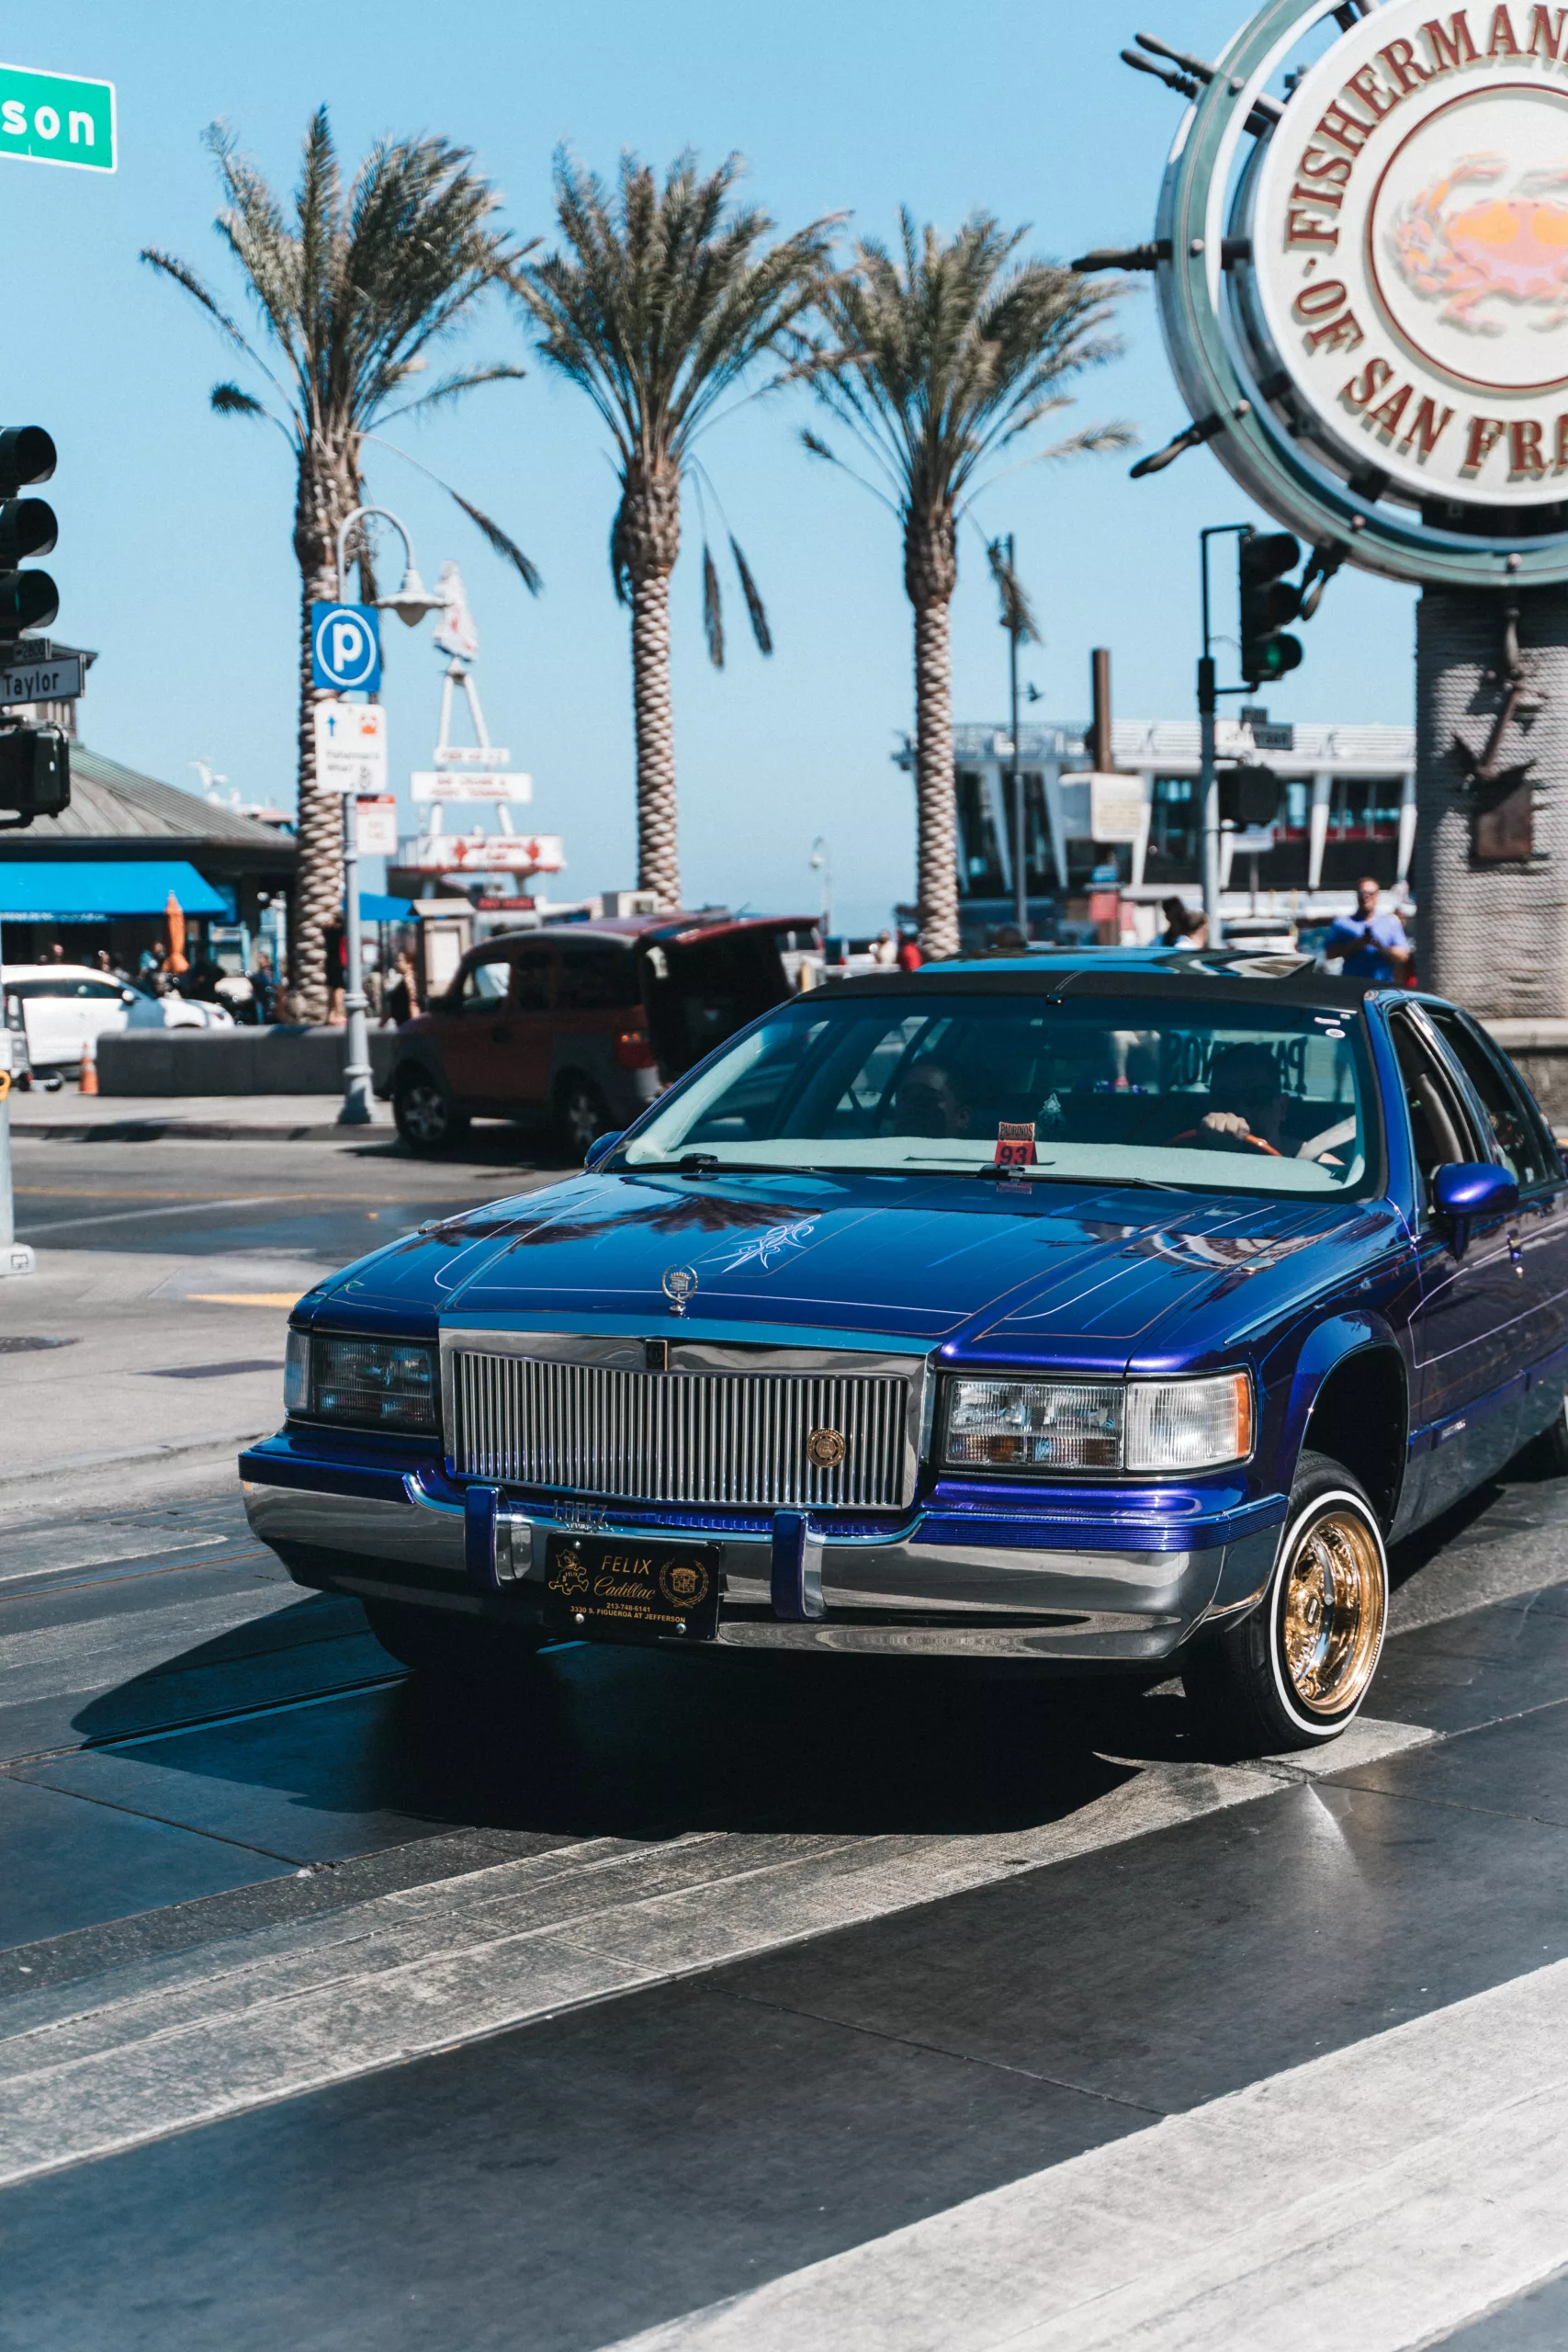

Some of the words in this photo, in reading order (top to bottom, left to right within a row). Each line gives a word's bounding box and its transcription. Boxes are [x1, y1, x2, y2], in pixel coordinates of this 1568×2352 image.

[2, 99, 96, 147] son
[1295, 279, 1365, 346] OF
[1343, 357, 1456, 454] SAN
[4, 670, 60, 699] Taylor
[1000, 1123, 1034, 1136] PADRINOS
[999, 1145, 1028, 1165] 93
[601, 1555, 652, 1576] FELIX
[593, 1575, 656, 1600] Cadillac
[570, 1605, 587, 1613] 3330
[596, 1608, 633, 1618] FIGUEROA
[644, 1613, 686, 1623] JEFFERSON
[606, 1602, 650, 1612] 213-748-6141
